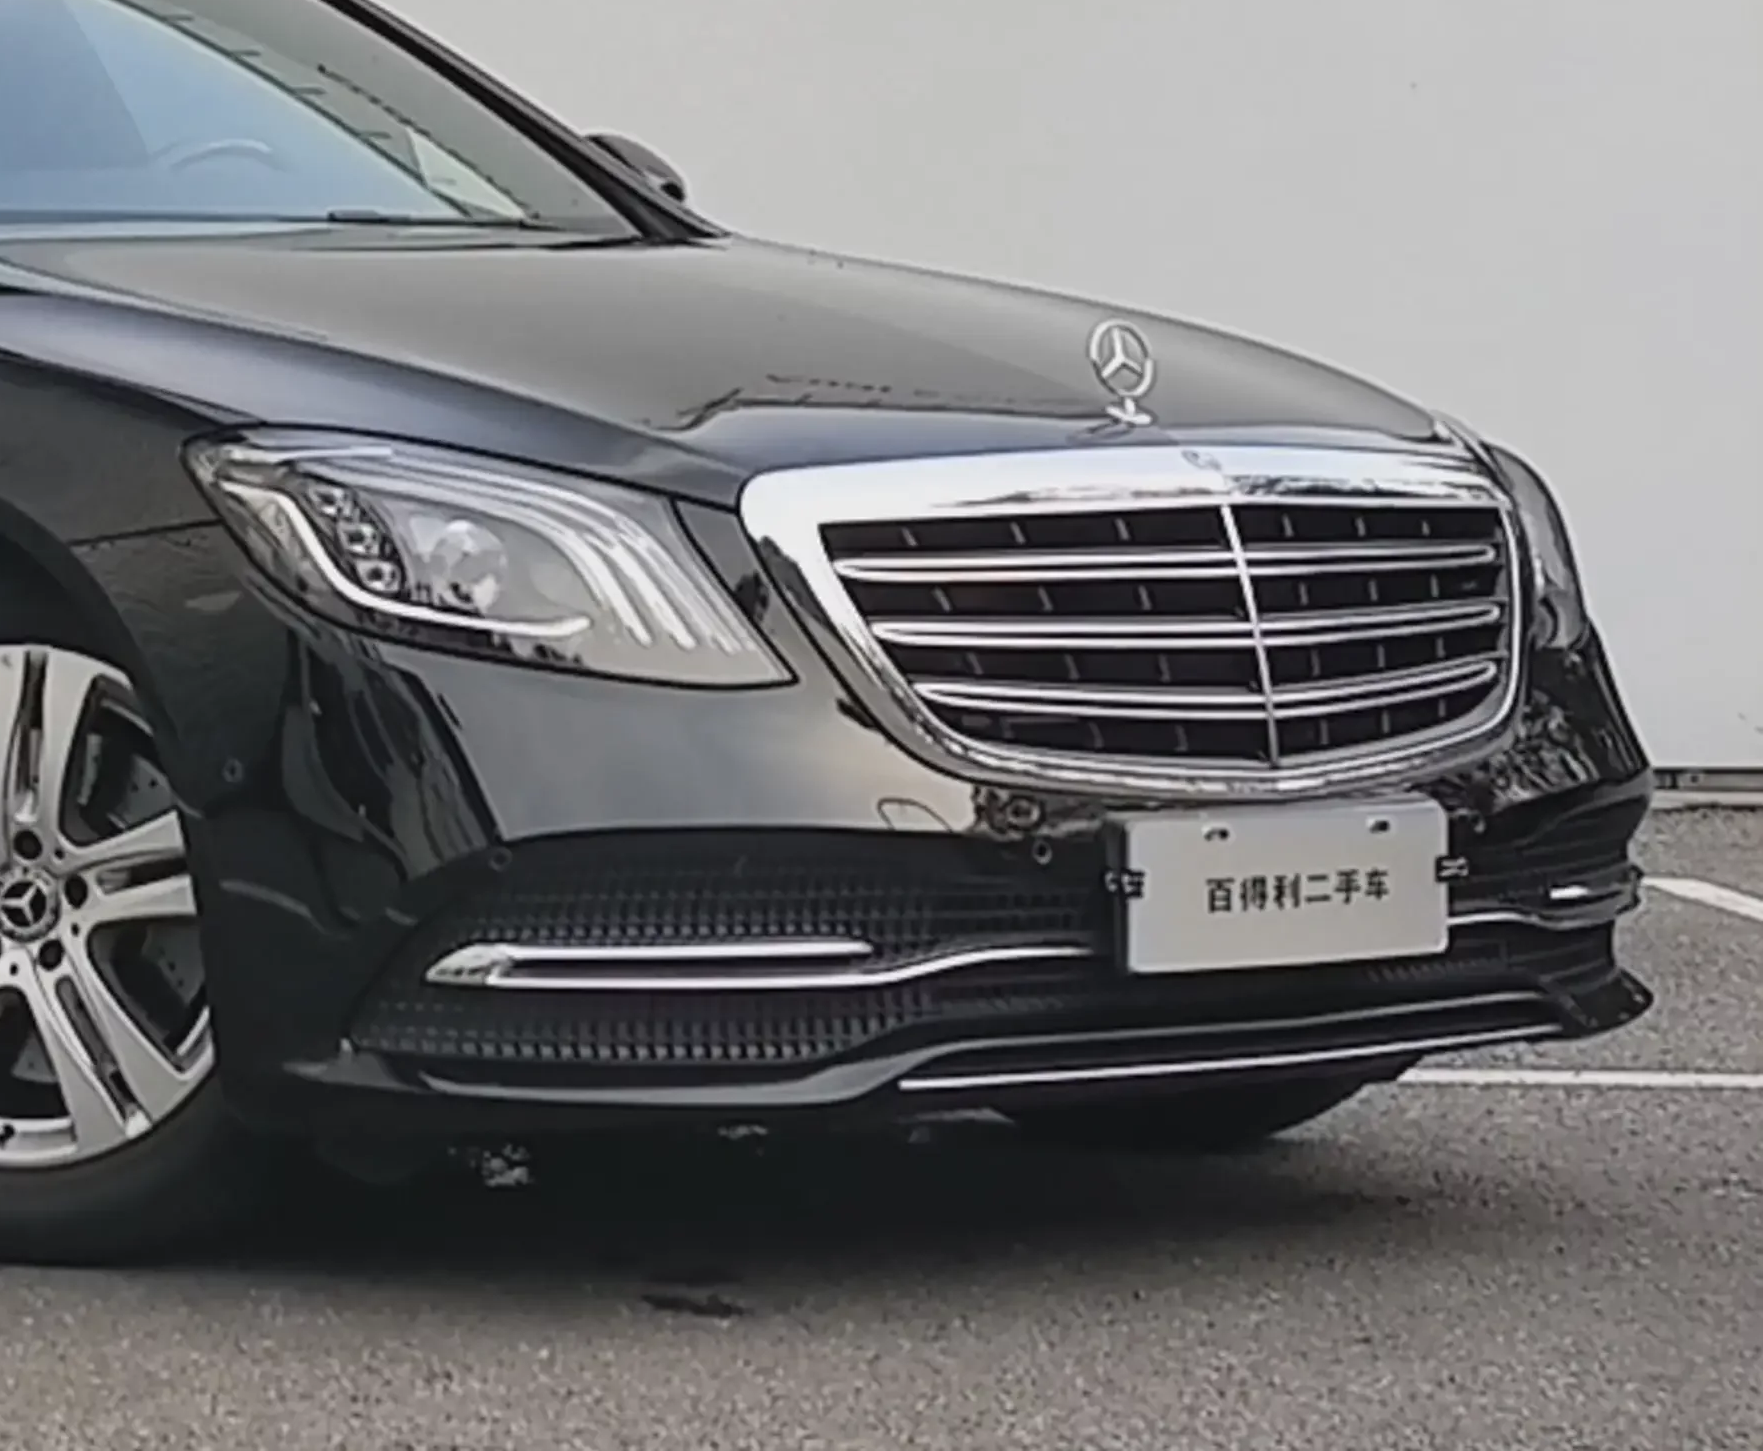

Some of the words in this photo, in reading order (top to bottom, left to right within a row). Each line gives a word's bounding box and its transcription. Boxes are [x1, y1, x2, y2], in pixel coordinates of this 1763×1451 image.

[1206, 868, 1390, 914] 百得利二手车
